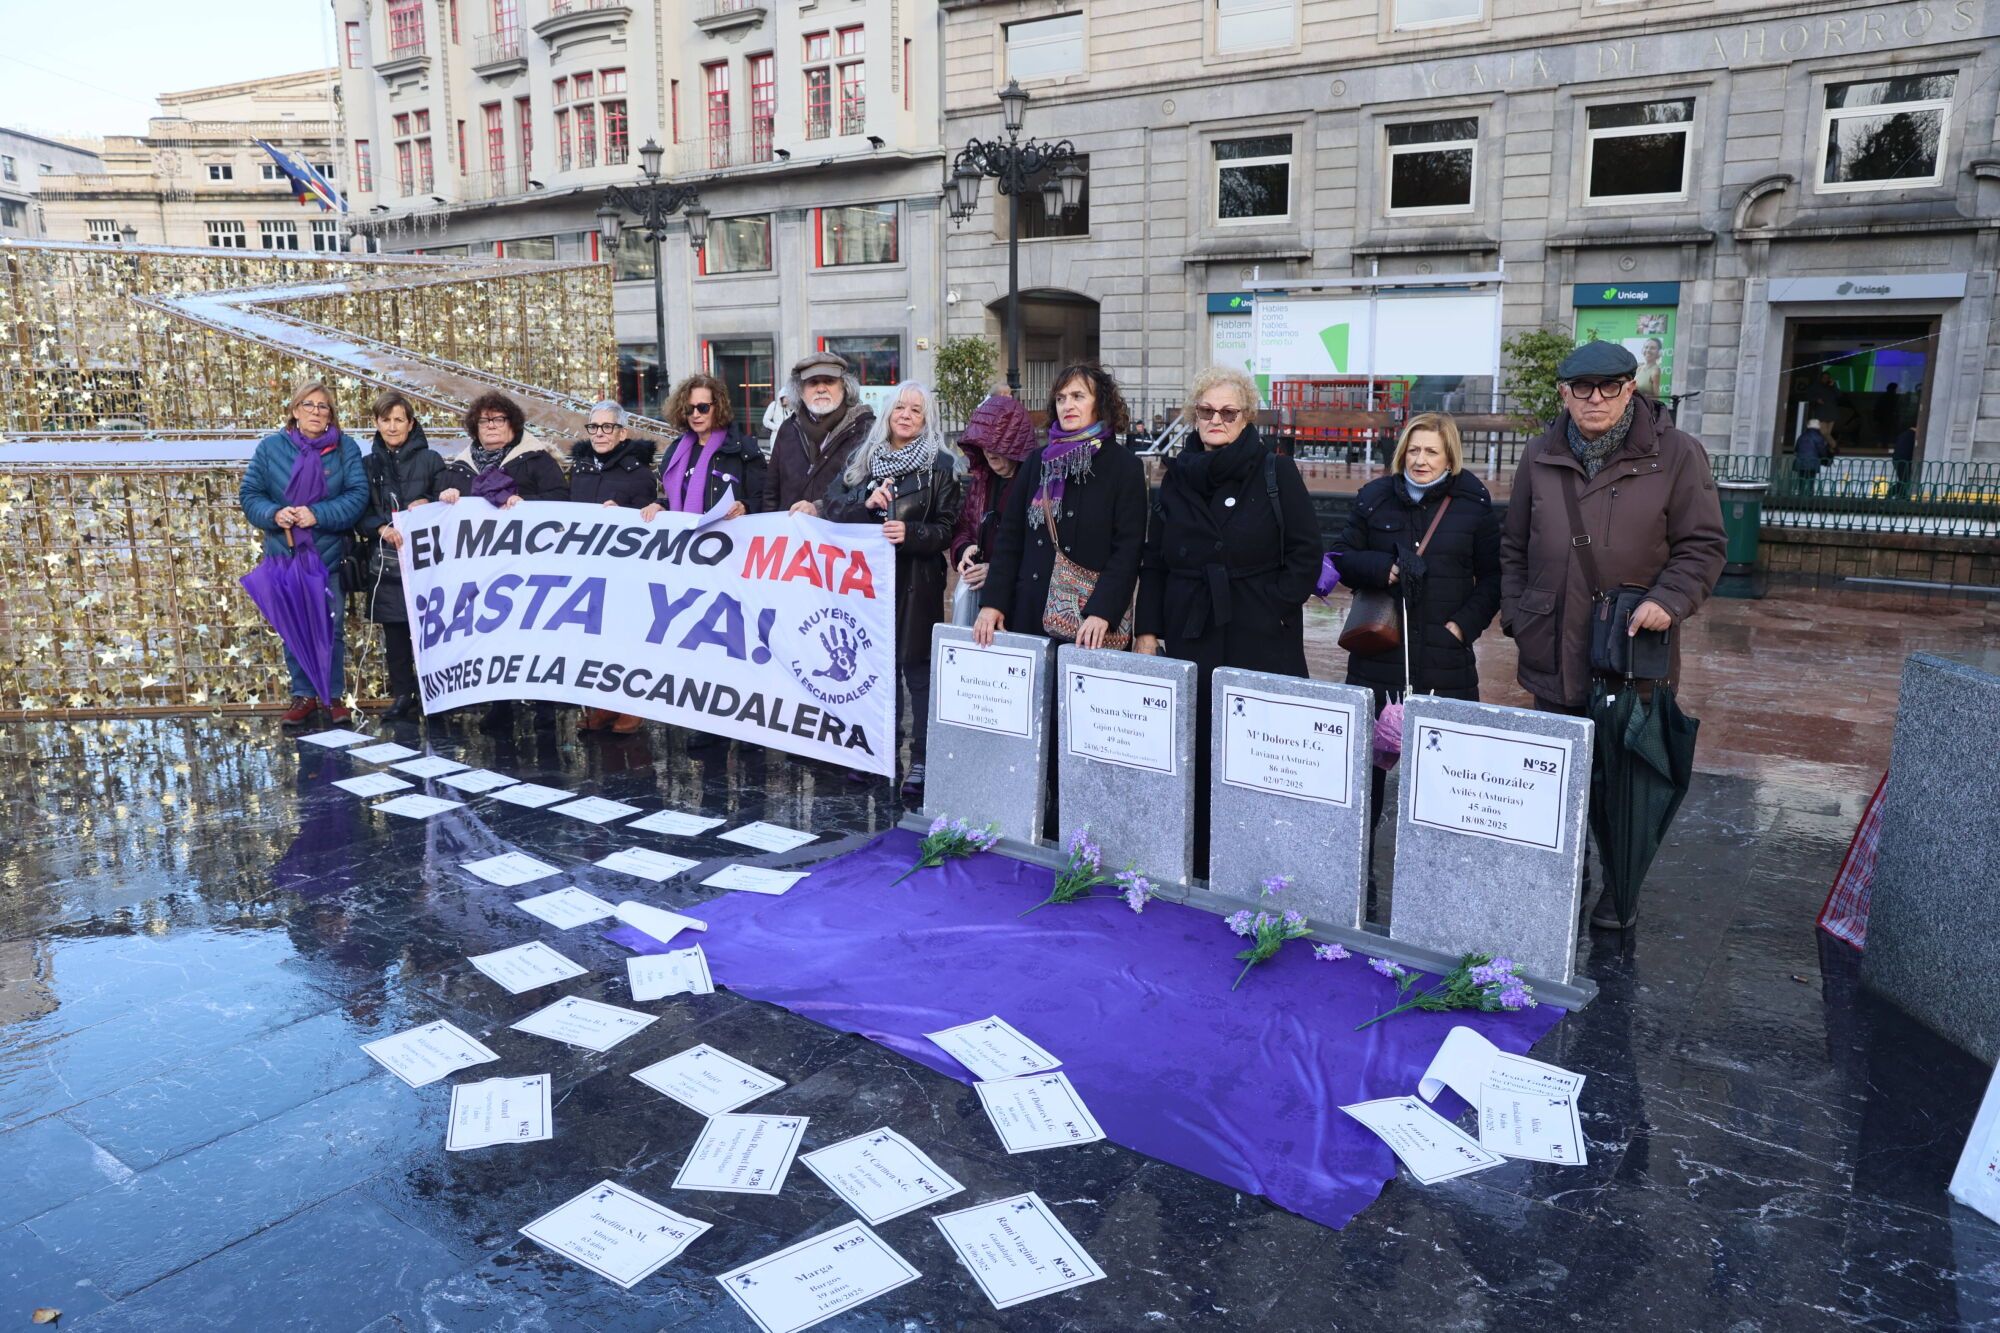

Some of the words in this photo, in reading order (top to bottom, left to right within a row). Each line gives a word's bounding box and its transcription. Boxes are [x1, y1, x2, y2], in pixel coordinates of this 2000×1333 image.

[1430, 48, 1550, 91] CAJA
[1599, 41, 1644, 74] DE
[1701, 1, 1976, 62] AHORROS
[1617, 291, 1649, 300] Unicaja
[1854, 285, 1890, 295] Unicaja
[1262, 304, 1288, 312] Hables
[1216, 320, 1252, 329] Hablam
[454, 519, 734, 568] MACHISMO
[741, 535, 876, 600] MATA
[644, 582, 777, 665] YA!
[798, 608, 856, 636] MUYERES
[856, 627, 872, 650] DE
[792, 660, 802, 678] LA
[800, 674, 879, 704] ESCANDALERA
[960, 674, 990, 686] Karilenia
[992, 679, 1009, 689] C.G.
[1021, 668, 1026, 677] 6
[486, 654, 525, 685] DE
[525, 654, 566, 686] LA
[574, 658, 874, 757] ESCANDALERA
[1090, 703, 1119, 716] Susana
[1122, 709, 1147, 721] Sierra
[1113, 725, 1144, 738] (Asturias)
[1262, 731, 1299, 747] Dolores
[1303, 738, 1324, 751] F.G.
[1116, 737, 1130, 746] años
[1250, 747, 1279, 760] Laviana
[1281, 753, 1319, 768] (Asturias)
[1269, 764, 1278, 772] 86
[1280, 765, 1297, 775] años
[1441, 764, 1477, 781] Noelia
[1480, 770, 1535, 791] González
[1263, 774, 1303, 790] 02/07/2025
[1449, 785, 1476, 798] Avilés
[1478, 790, 1523, 807] (Asturias)
[1467, 801, 1479, 811] 45
[1481, 804, 1501, 815] años
[1460, 814, 1508, 831] 18/08/2025
[1406, 1122, 1430, 1143] Laura
[589, 1211, 629, 1232] Josefina
[986, 1232, 1019, 1267] Guadalajara
[995, 1216, 1018, 1235] Rami
[1009, 1235, 1041, 1265] Virginia
[793, 1262, 835, 1283] Marga
[808, 1275, 843, 1293] Burgos
[814, 1291, 829, 1300] 39
[827, 1282, 851, 1295] años
